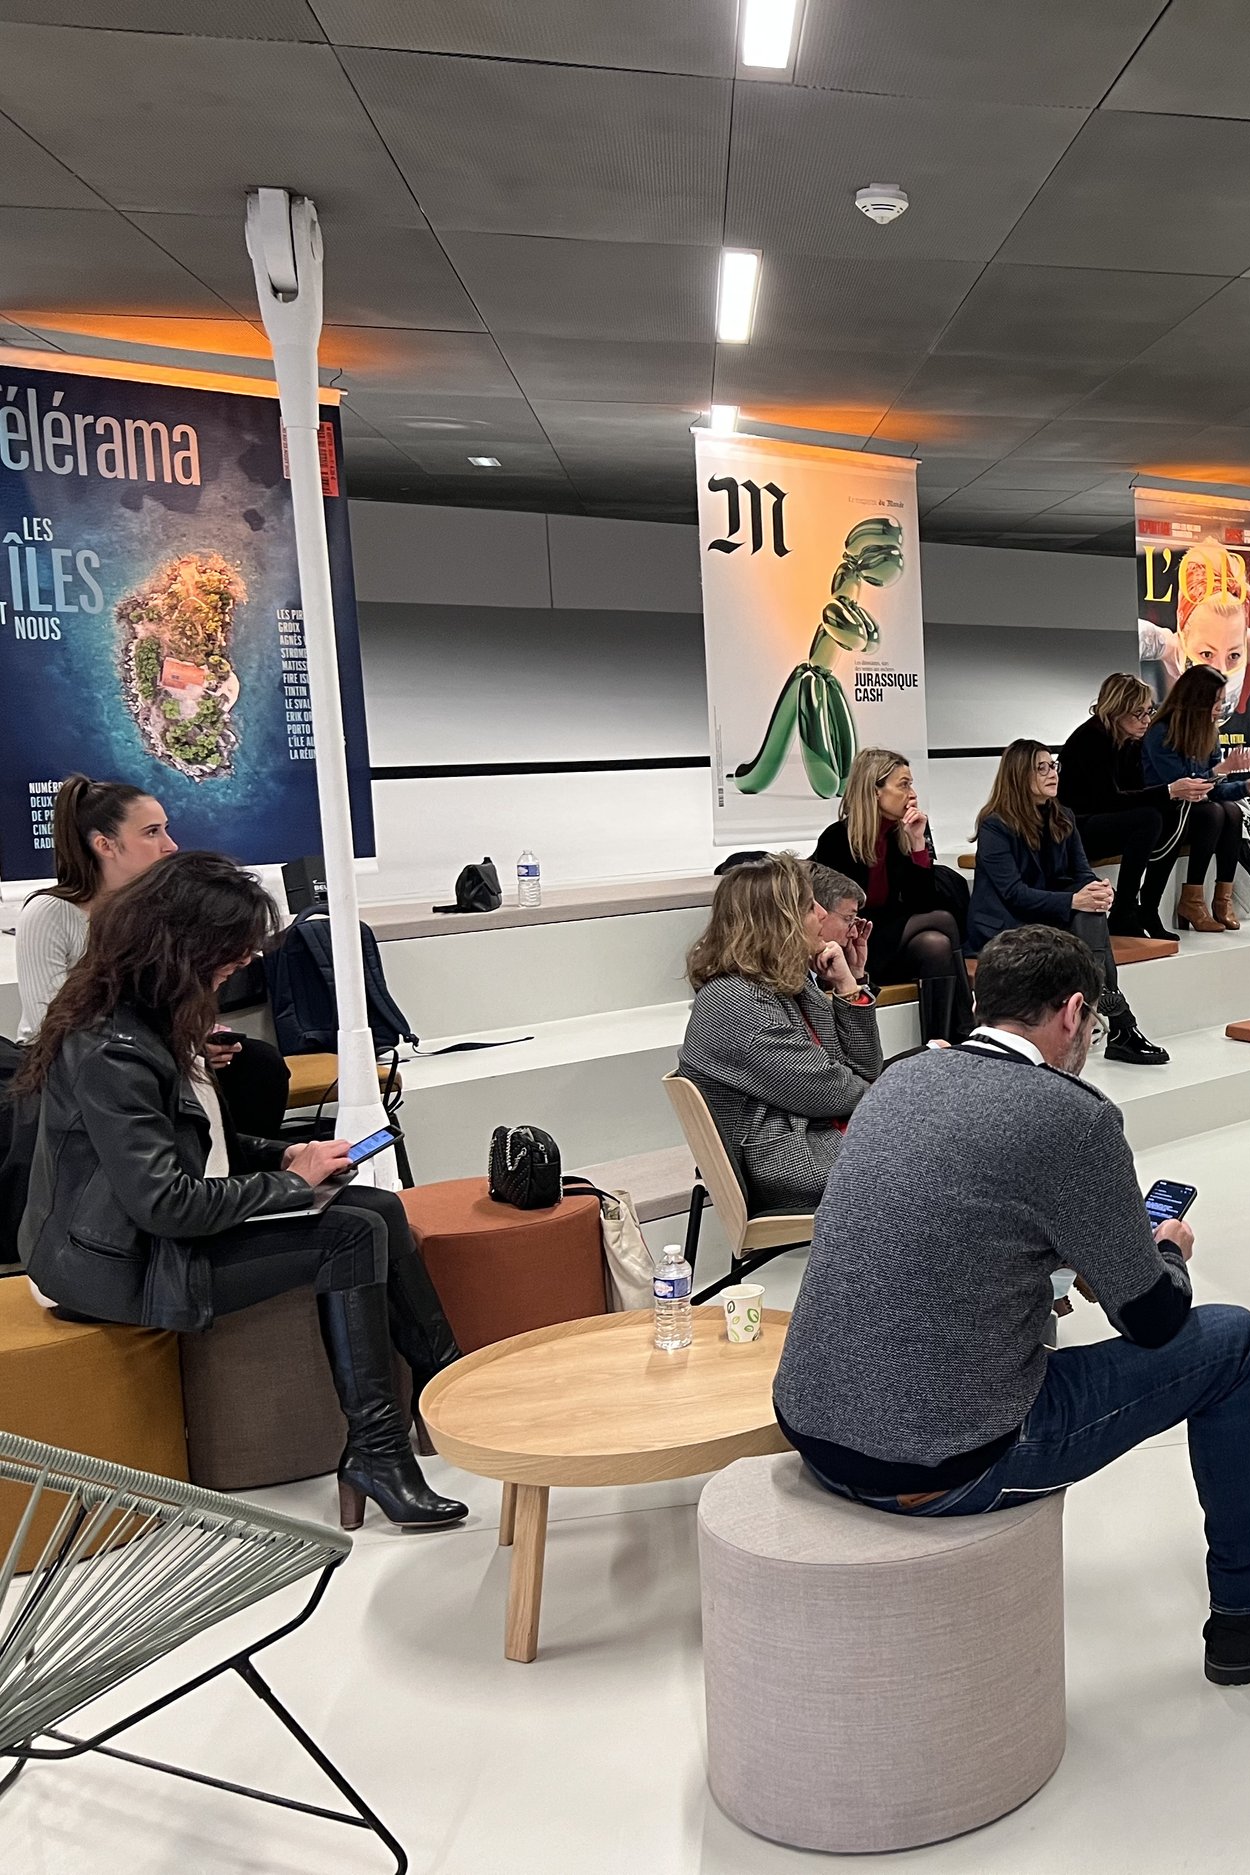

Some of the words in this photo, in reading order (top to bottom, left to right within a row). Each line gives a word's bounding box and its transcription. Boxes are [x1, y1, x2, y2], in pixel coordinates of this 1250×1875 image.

[0, 385, 201, 486] élérama
[707, 472, 793, 558] M
[22, 516, 54, 542] LES
[2, 531, 104, 615] ÎLES
[277, 609, 291, 620] LES
[14, 616, 62, 641] NOUS
[278, 622, 301, 633] GROIX
[280, 634, 303, 646] AGNÈS
[282, 660, 308, 671] MATISS
[284, 673, 299, 684] FIRE
[854, 672, 919, 691] JURASSIQUE
[284, 686, 308, 697] TINTIN
[854, 687, 884, 702] CASH
[285, 698, 294, 709] LE
[295, 698, 312, 709] SVAL
[286, 711, 303, 722] ERIK
[287, 723, 311, 735] PORTO
[290, 749, 299, 760] LA
[300, 747, 316, 760] RÉU
[31, 796, 53, 807] DEUX
[32, 810, 42, 821] DE
[33, 821, 54, 835] CINÉ
[34, 837, 55, 849] RADI
